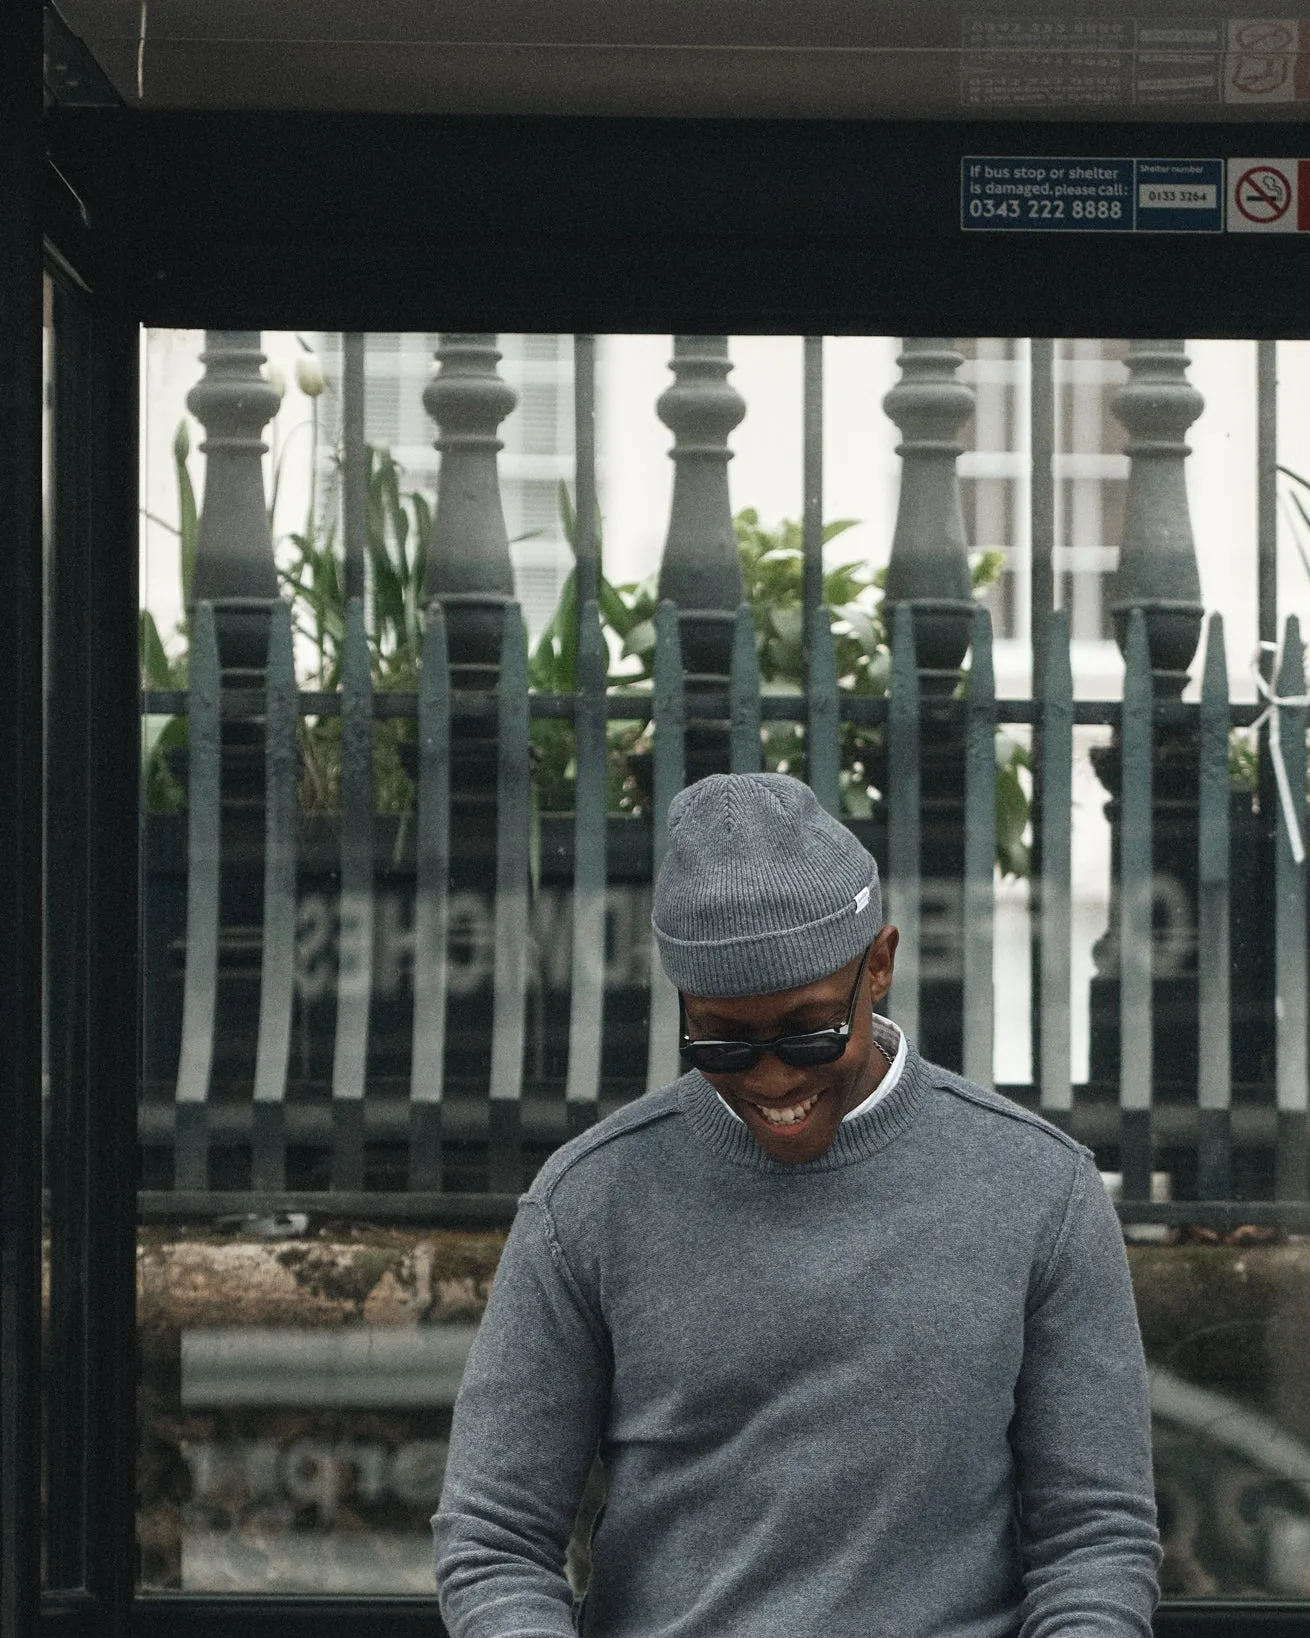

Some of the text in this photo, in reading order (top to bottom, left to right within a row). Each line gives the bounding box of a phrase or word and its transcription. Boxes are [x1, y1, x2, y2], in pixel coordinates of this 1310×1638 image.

[969, 165, 1119, 182] If bus stop or shelter
[1139, 164, 1204, 174] Shelter number
[969, 182, 982, 194] is
[1055, 184, 1096, 197] please
[1097, 184, 1128, 196] call:
[969, 200, 1122, 219] 0343 222 8888
